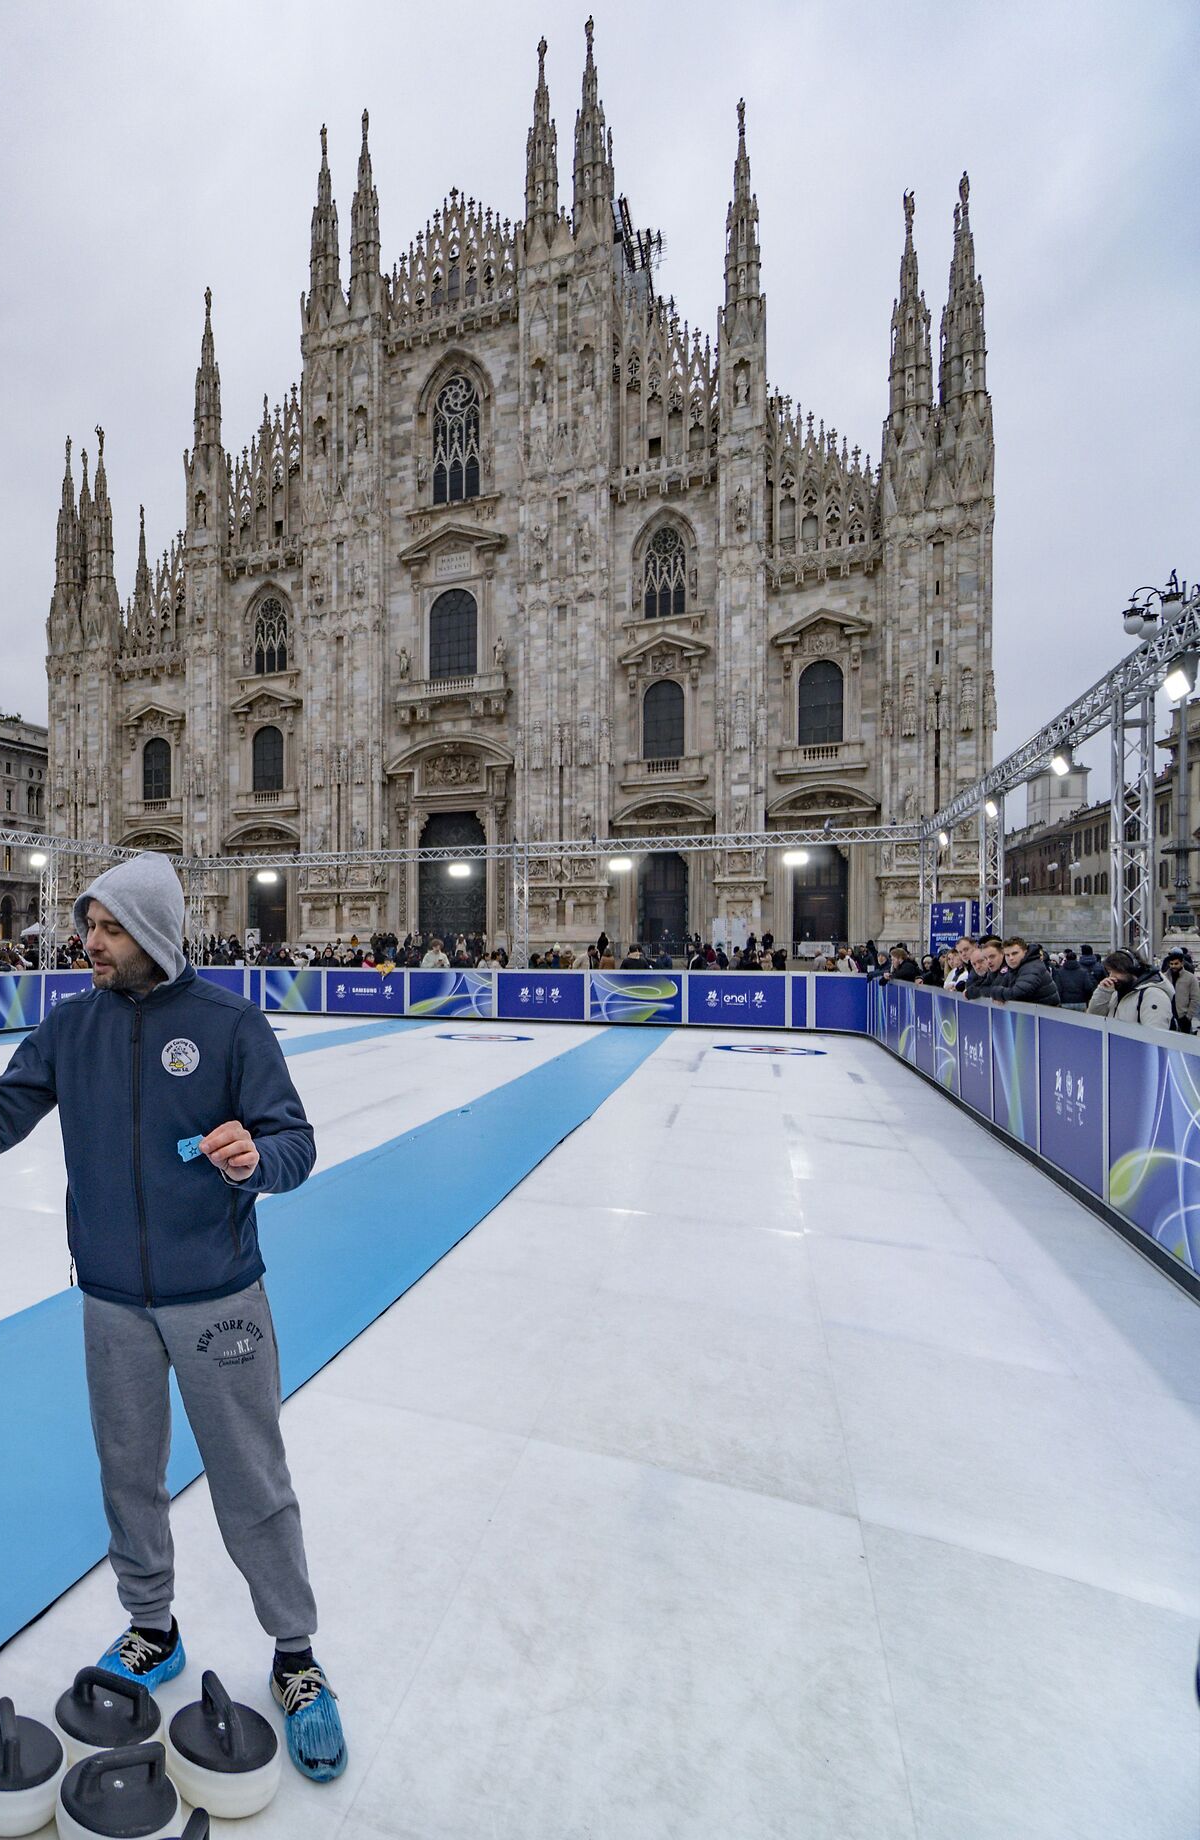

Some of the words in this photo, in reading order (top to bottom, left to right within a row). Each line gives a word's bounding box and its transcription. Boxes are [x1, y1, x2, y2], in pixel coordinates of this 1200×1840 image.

[723, 993, 748, 1003] enel
[196, 1329, 214, 1353] NEW
[214, 1319, 244, 1333] YORK
[245, 1321, 264, 1342] CITY
